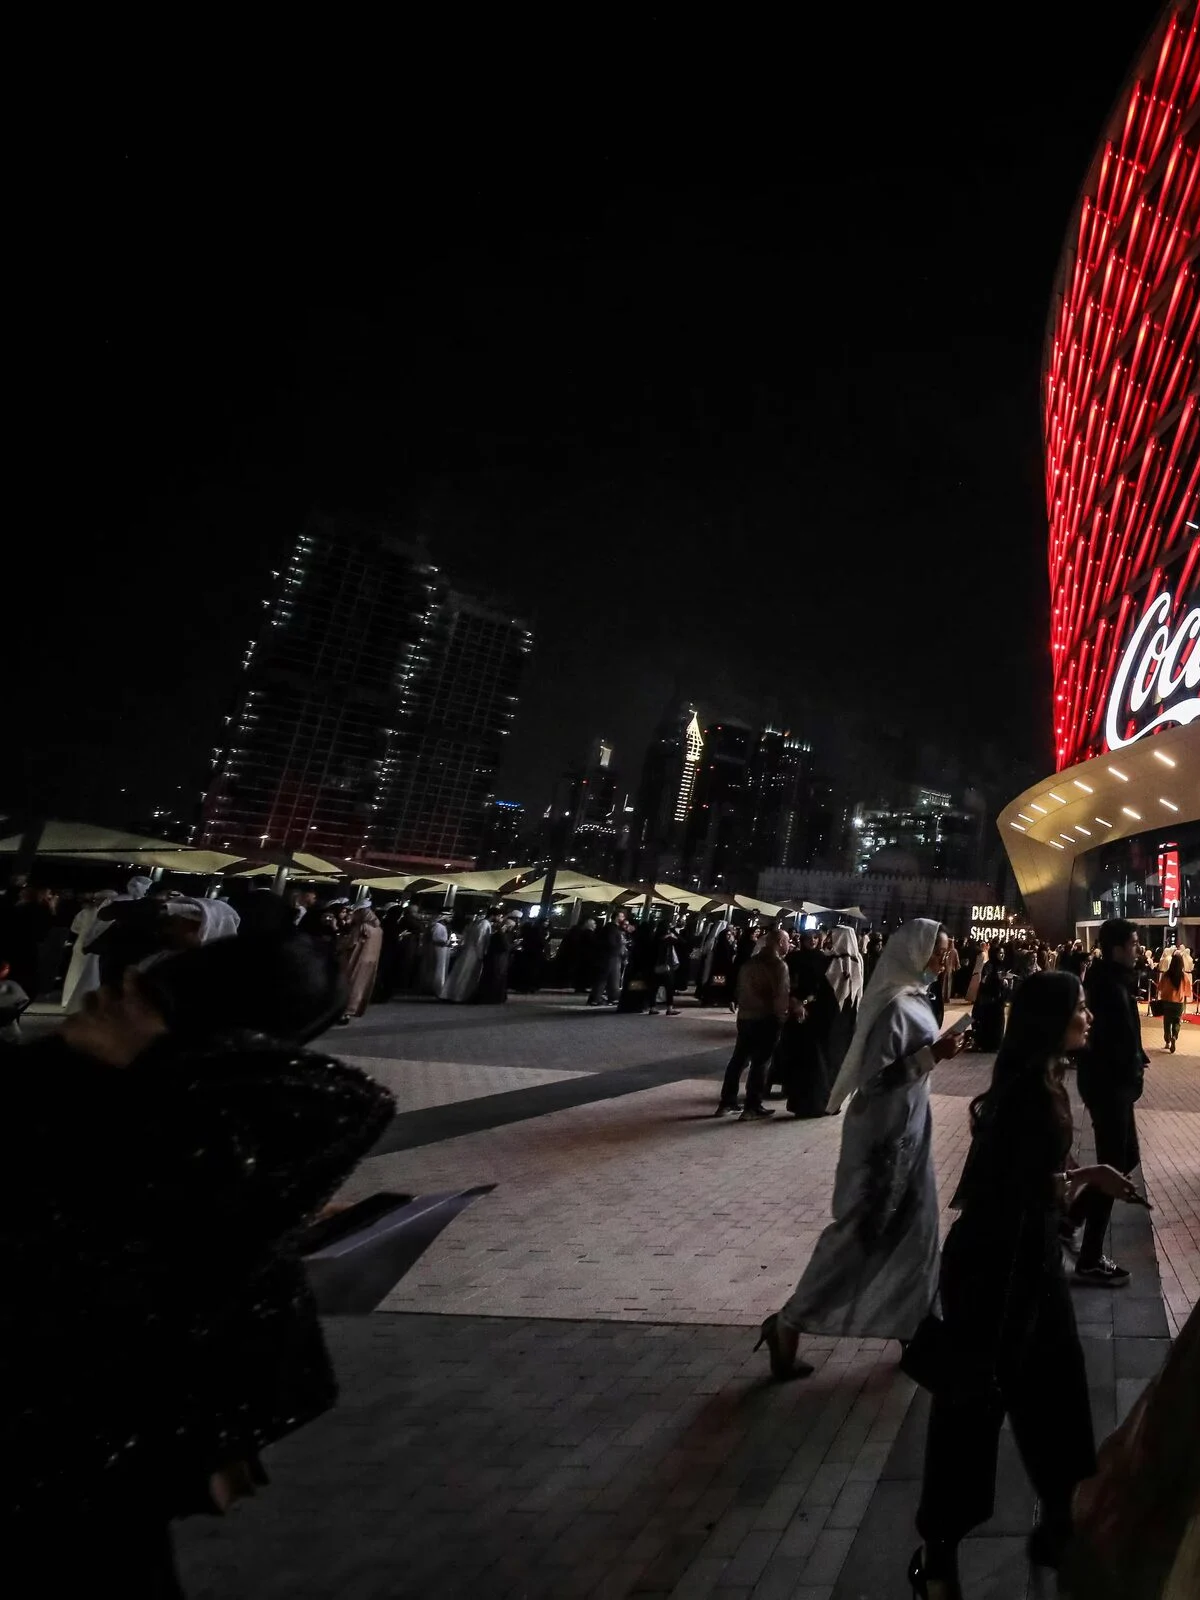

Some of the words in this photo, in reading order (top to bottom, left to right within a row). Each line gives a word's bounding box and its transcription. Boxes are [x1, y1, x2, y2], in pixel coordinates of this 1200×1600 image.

[971, 905, 1006, 921] DUBAI
[1169, 900, 1178, 927] C
[969, 926, 1027, 943] SHOPPING
